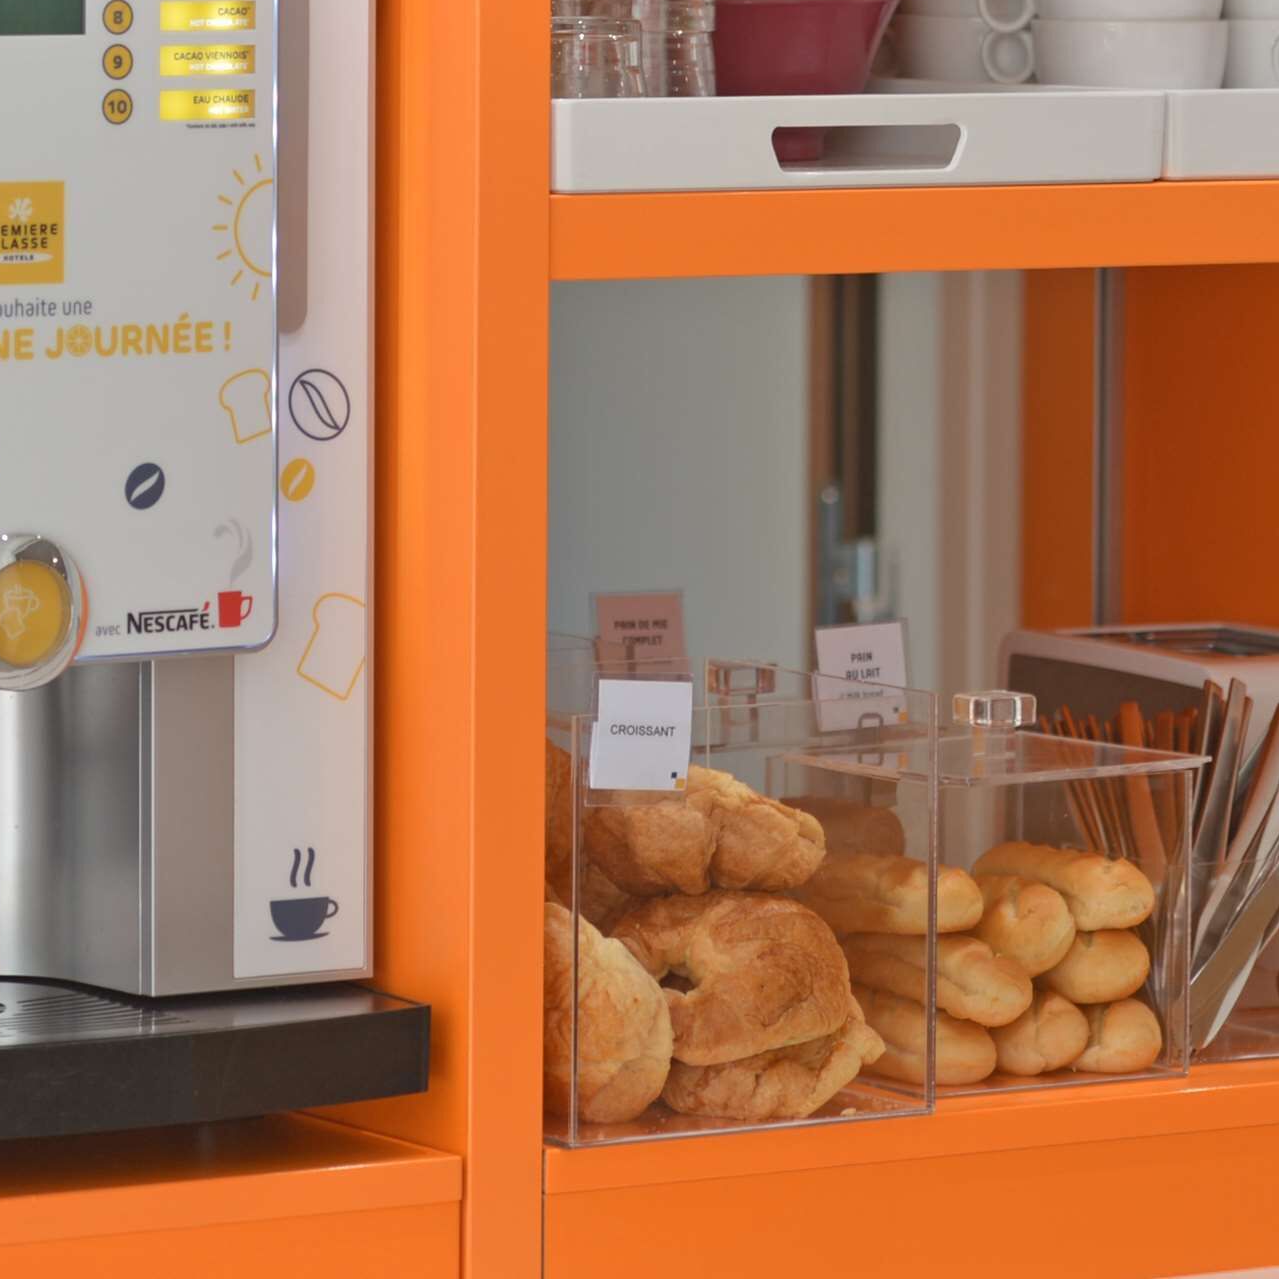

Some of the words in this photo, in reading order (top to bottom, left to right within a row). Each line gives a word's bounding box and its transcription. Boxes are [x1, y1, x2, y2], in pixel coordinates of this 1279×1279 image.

[113, 11, 124, 25] 8
[218, 7, 248, 16] CACAO
[174, 51, 203, 61] CACAO
[205, 50, 248, 60] VIENNOIS
[112, 55, 123, 70] 9
[193, 95, 211, 104] EAU
[213, 94, 249, 104] CHAUDE
[107, 100, 128, 115] 10
[3, 253, 35, 262] HOTELS
[62, 299, 93, 316] une
[95, 623, 120, 638] avec
[127, 601, 211, 635] NESCAFÉ
[851, 652, 872, 662] PAIN
[846, 669, 858, 680] AU
[860, 667, 880, 679] LAIT
[610, 724, 677, 738] CROISSANT
